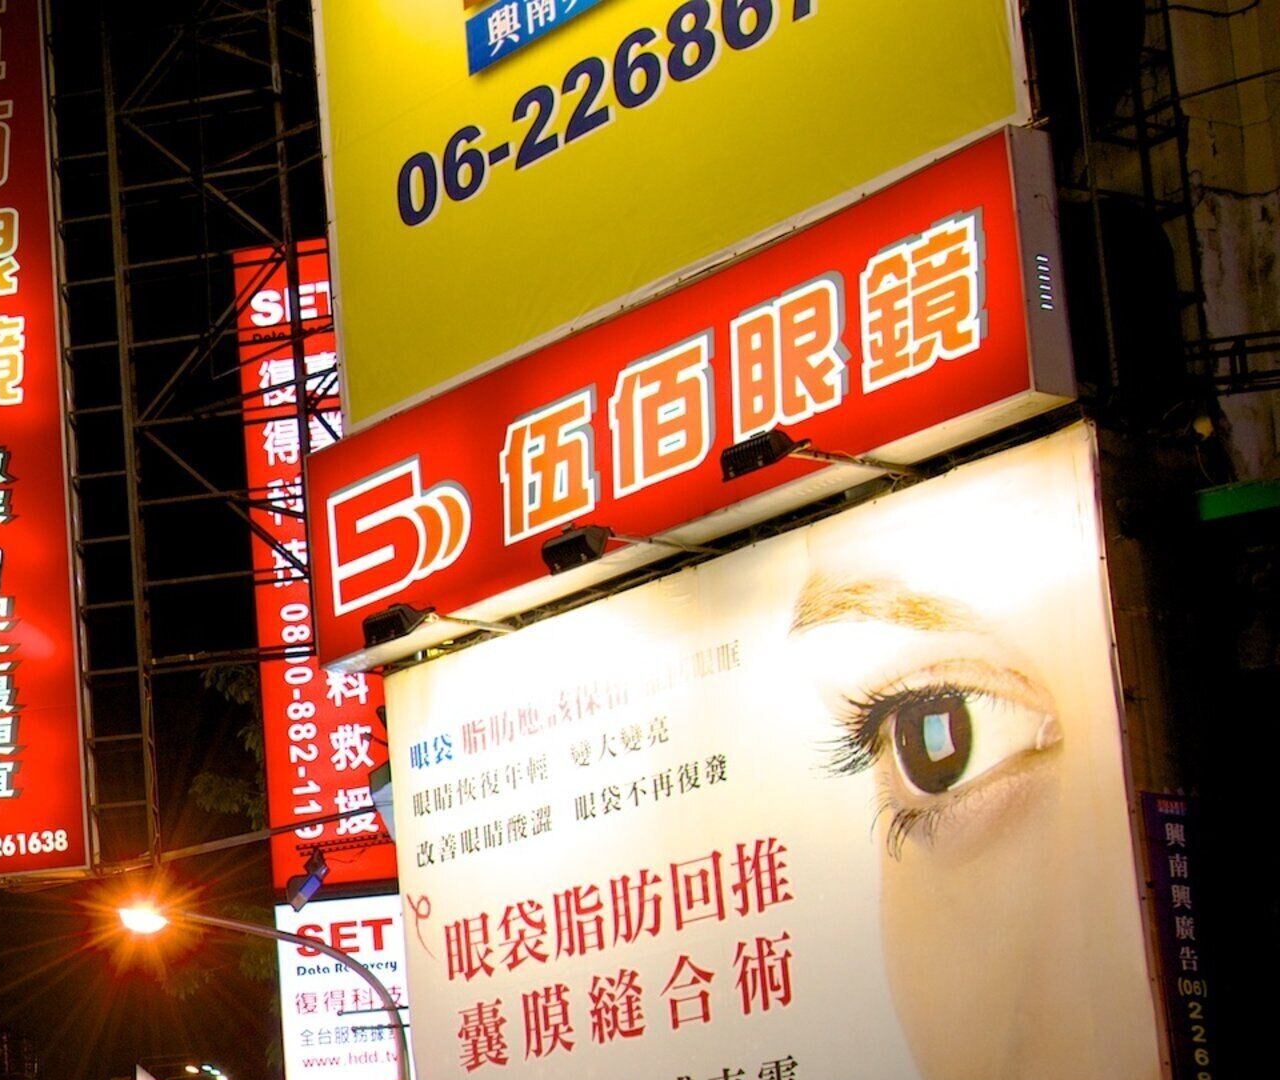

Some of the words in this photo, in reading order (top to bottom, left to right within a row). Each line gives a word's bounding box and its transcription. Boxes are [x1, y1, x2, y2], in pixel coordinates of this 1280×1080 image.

[498, 206, 987, 547] 伍佰眼鏡
[574, 752, 729, 823] 眼袋不再復發
[295, 917, 394, 958] SET
[443, 836, 795, 983] 眼袋脂肪回推
[295, 964, 331, 977] Data
[457, 930, 794, 1074] 囊膜縫合術
